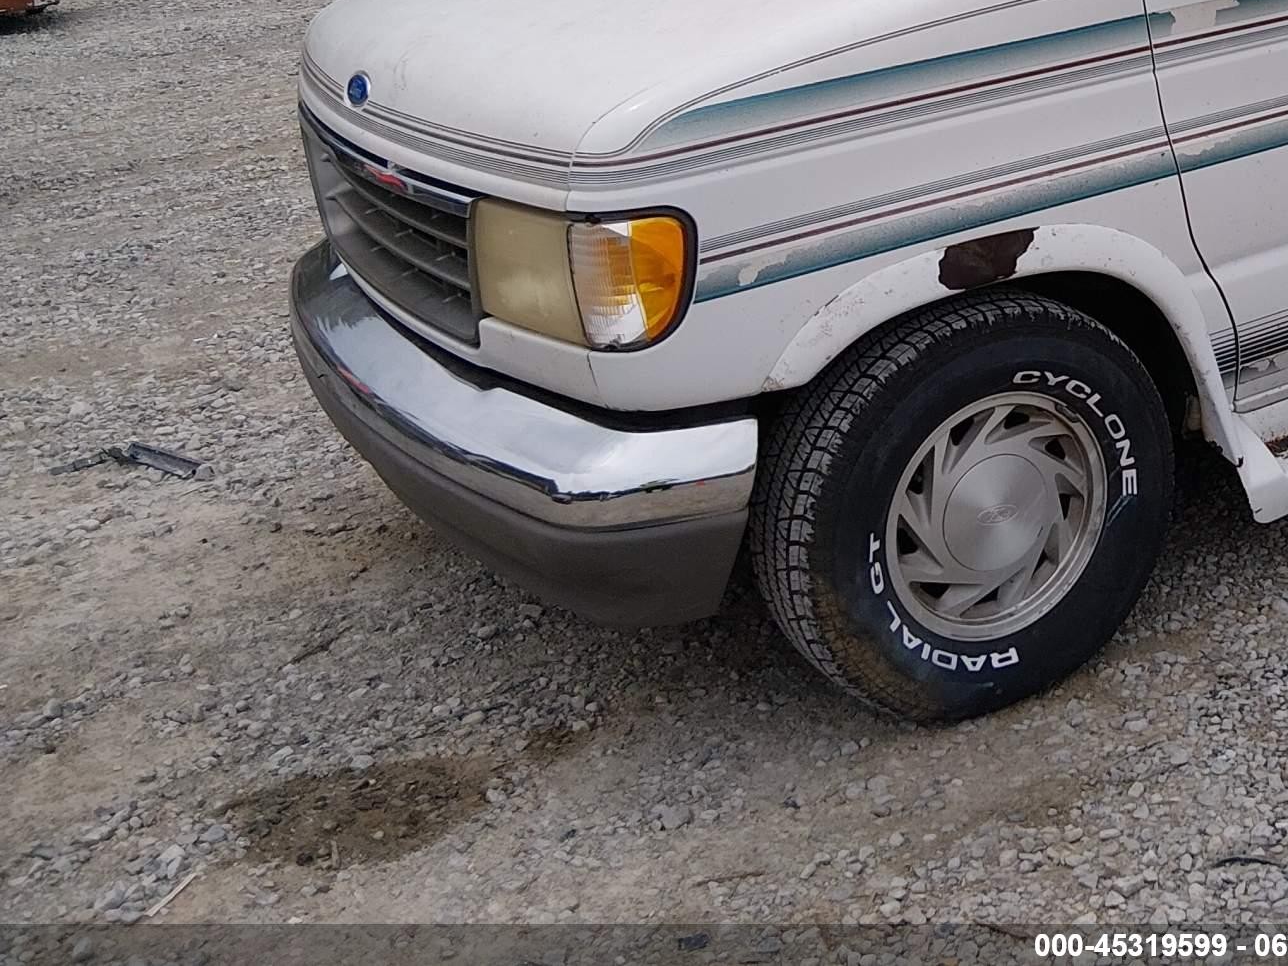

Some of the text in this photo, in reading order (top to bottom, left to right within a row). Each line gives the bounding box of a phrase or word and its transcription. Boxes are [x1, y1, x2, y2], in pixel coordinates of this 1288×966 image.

[1012, 370, 1138, 497] CYCLONE
[868, 532, 1020, 672] RADIAL GT
